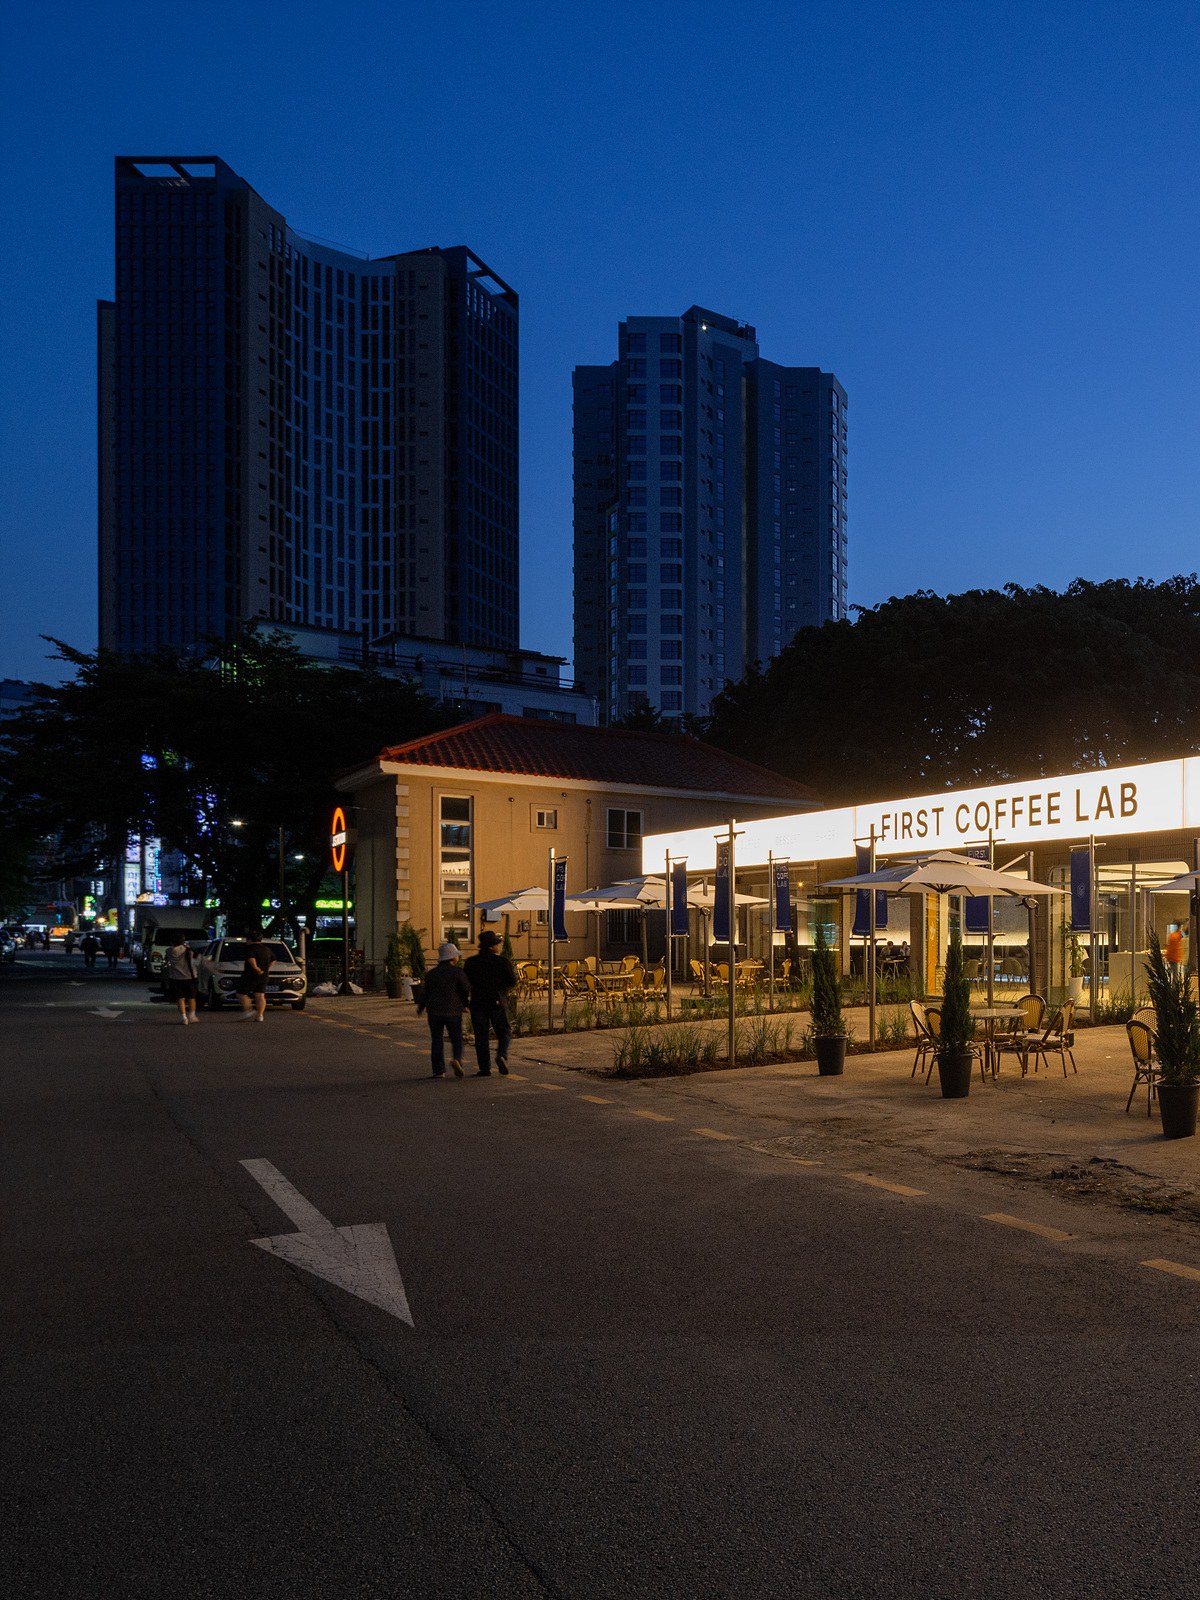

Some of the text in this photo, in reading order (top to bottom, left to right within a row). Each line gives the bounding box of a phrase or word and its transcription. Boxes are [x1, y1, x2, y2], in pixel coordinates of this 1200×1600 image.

[881, 782, 1138, 841] FIRST COFFEE LAB
